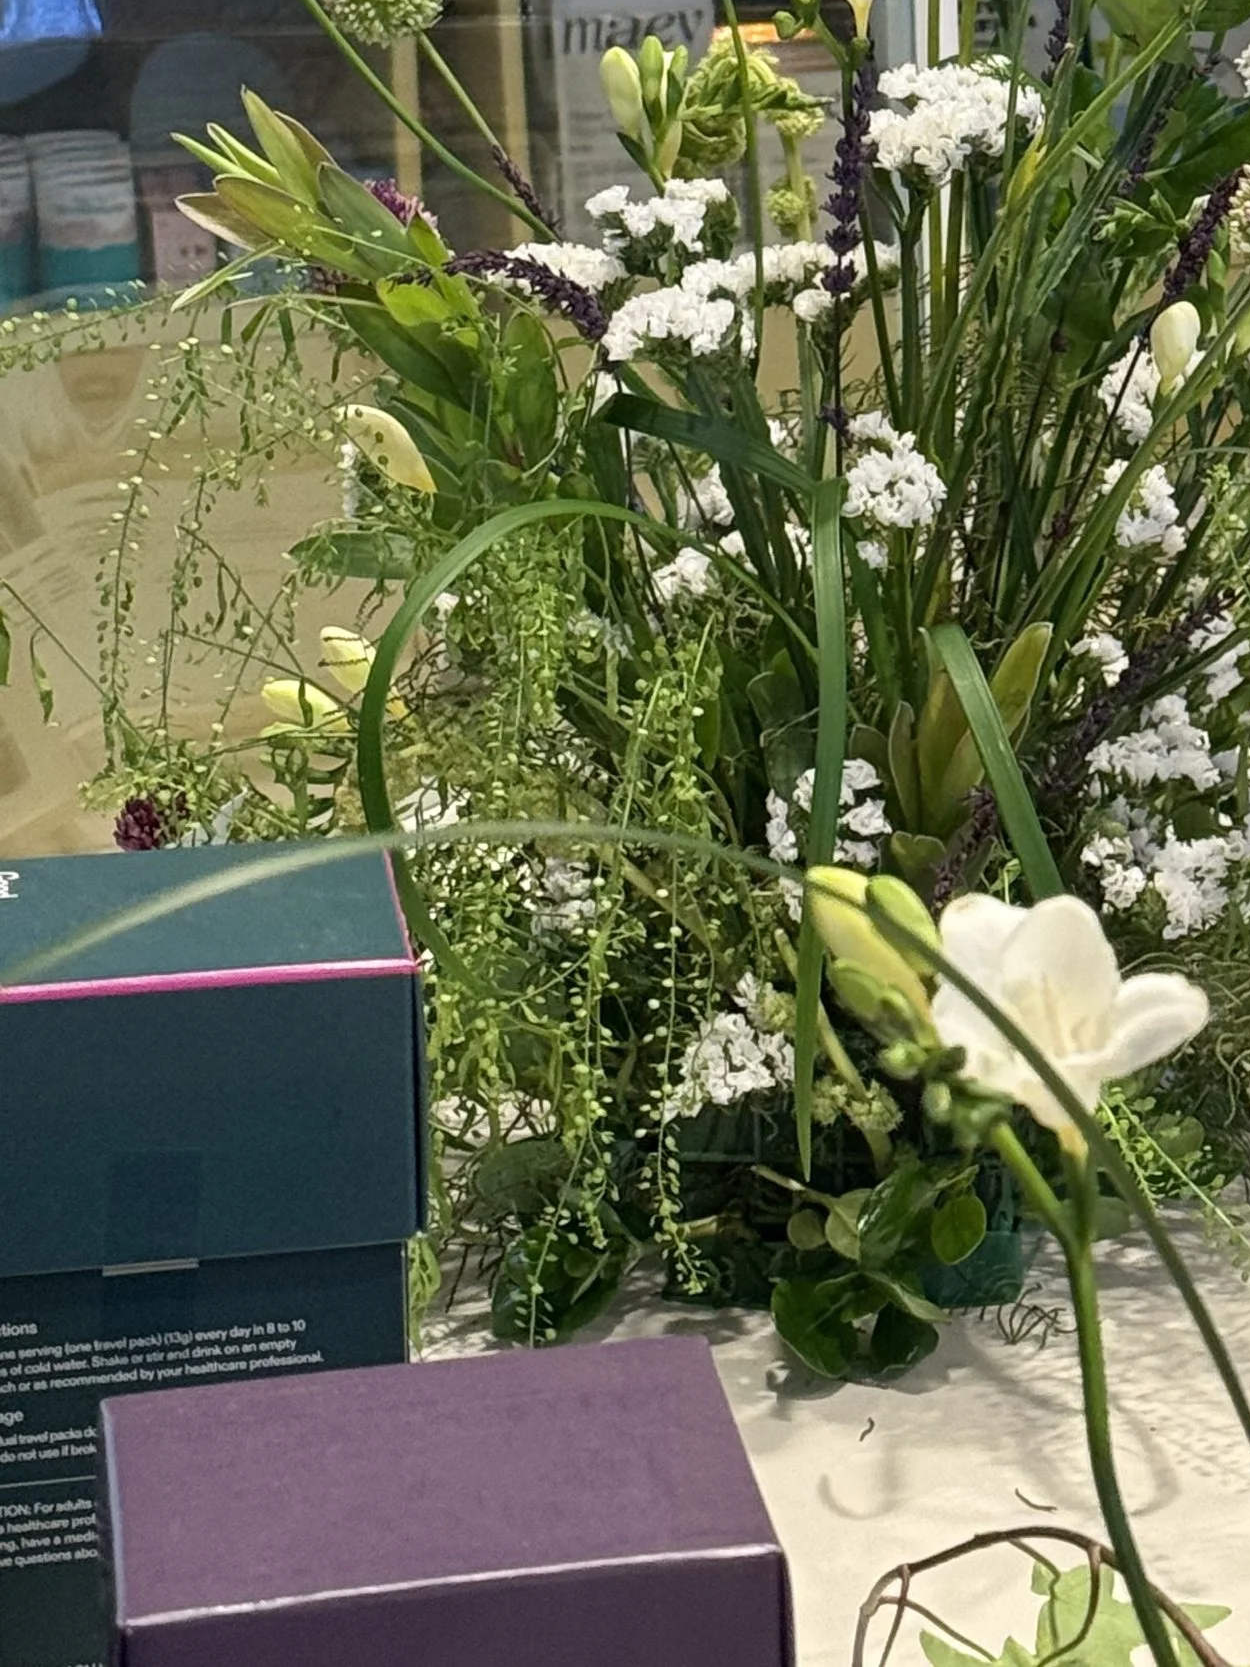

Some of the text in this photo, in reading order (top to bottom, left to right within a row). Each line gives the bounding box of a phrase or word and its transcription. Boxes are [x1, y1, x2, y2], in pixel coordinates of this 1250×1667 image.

[563, 9, 704, 55] maev
[195, 1329, 228, 1341] every
[230, 1325, 252, 1338] day
[266, 1322, 276, 1334] 8
[292, 1319, 306, 1331] 10
[24, 1362, 51, 1375] cold
[192, 1345, 223, 1359] drink
[224, 1344, 240, 1355] on
[259, 1339, 297, 1351] empty
[50, 1368, 138, 1389] recommended
[140, 1368, 155, 1382] by
[156, 1367, 183, 1382] your
[185, 1361, 248, 1376] healthcare
[250, 1351, 325, 1372] professional.
[17, 1448, 37, 1461] not
[38, 1448, 60, 1460] use
[33, 1502, 55, 1514] For
[6, 1519, 70, 1534] healthcare
[14, 1550, 72, 1568] questions
